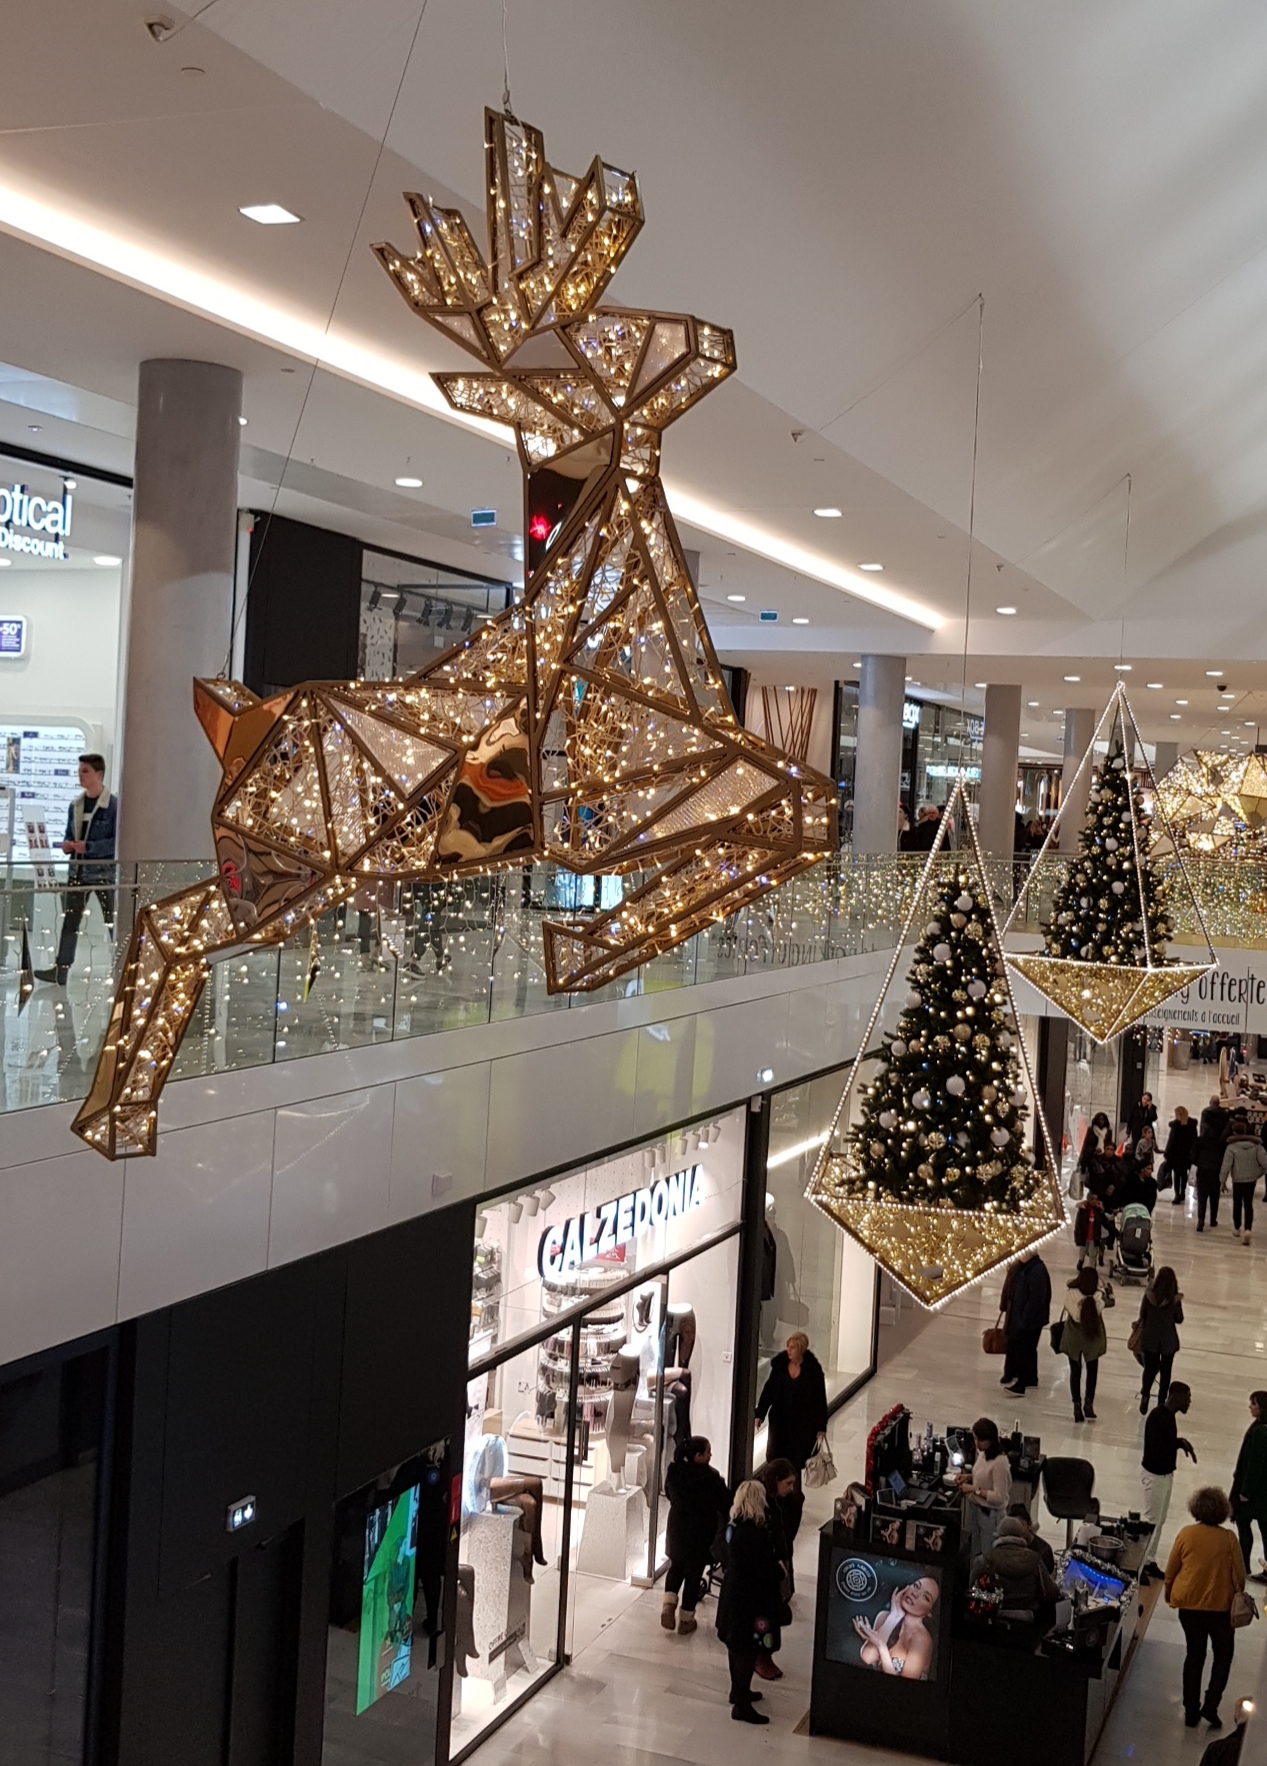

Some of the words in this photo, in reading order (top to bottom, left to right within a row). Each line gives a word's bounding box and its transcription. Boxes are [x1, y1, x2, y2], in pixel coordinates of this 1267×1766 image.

[0, 525, 65, 560] Discount
[1146, 1007, 1199, 1023] nseignements
[1208, 1010, 1240, 1026] l'accueil
[537, 1163, 706, 1278] CALZEDONIA
